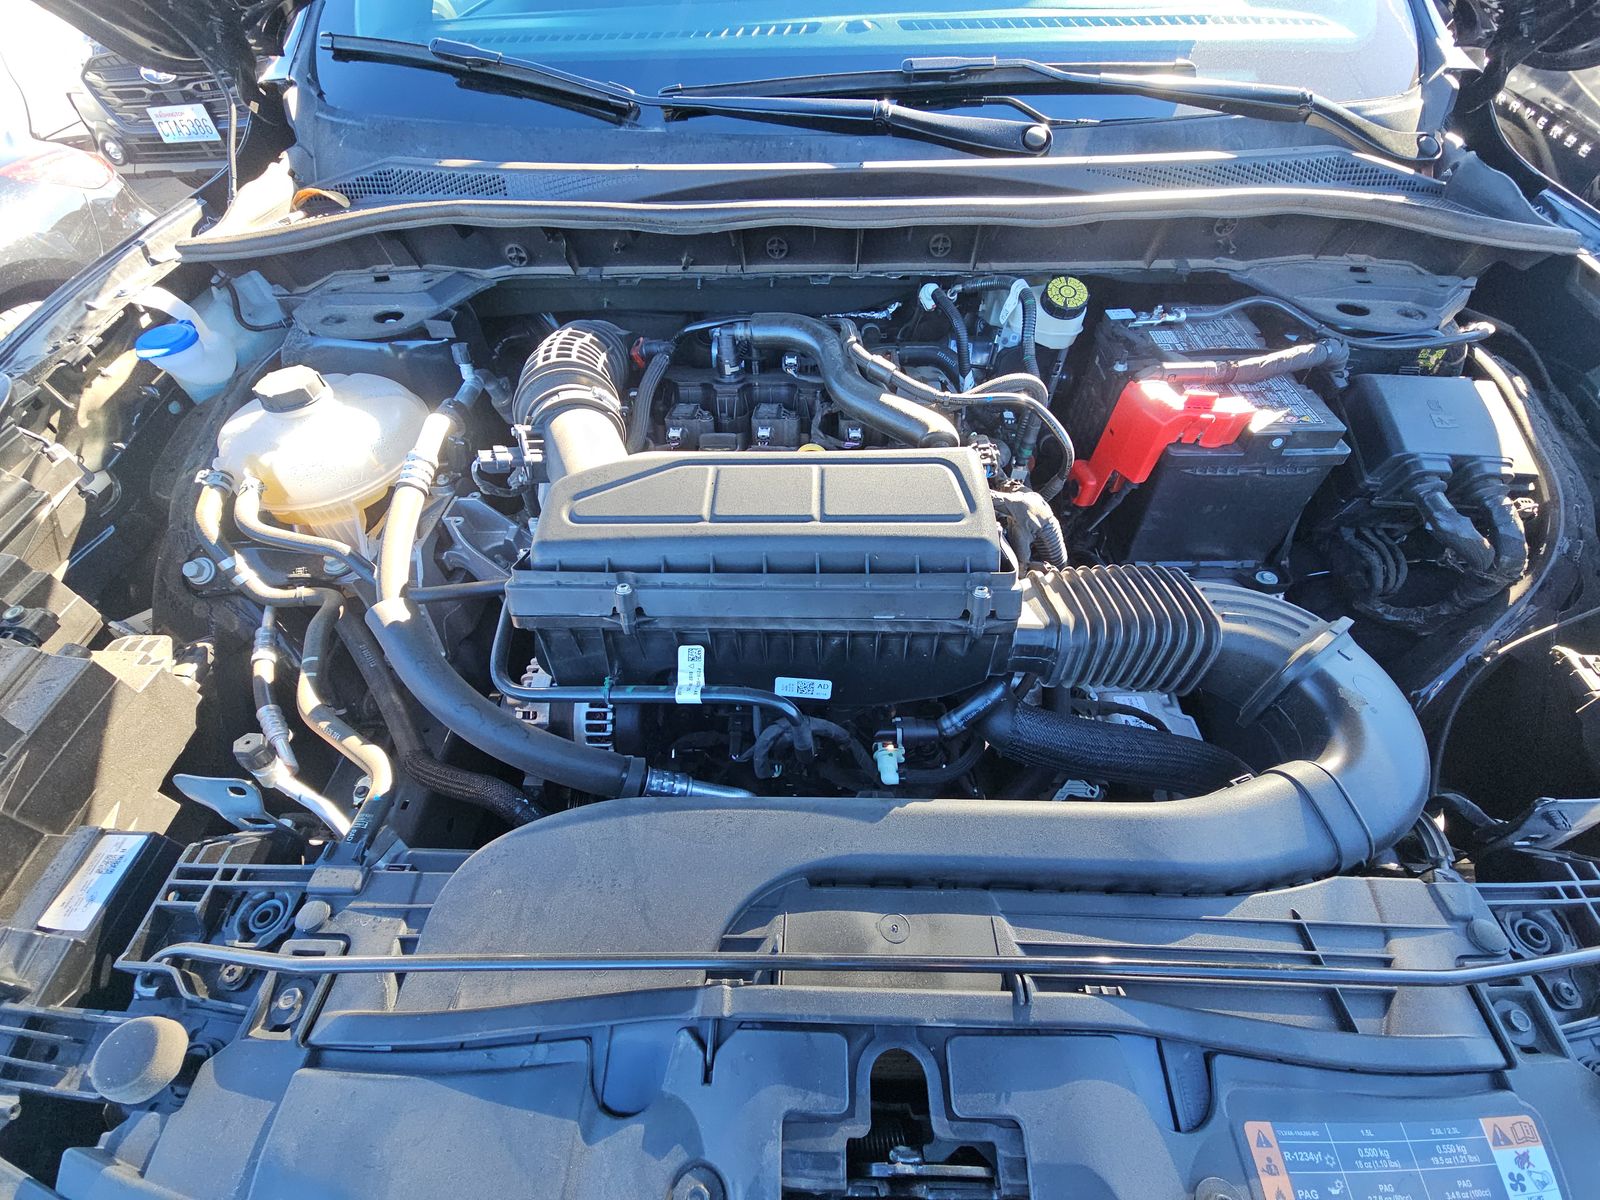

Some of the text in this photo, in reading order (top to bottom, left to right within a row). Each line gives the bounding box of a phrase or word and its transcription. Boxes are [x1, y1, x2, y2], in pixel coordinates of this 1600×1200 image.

[157, 118, 214, 138] CTA5386
[1495, 90, 1592, 158] RAVERSE
[1360, 1129, 1374, 1137] 1.5L
[1357, 1147, 1390, 1160] 0.500 kg
[1436, 1143, 1468, 1155] 0.550 kg
[1283, 1151, 1324, 1164] R-1234yf
[1378, 1183, 1395, 1192] PAG
[1457, 1180, 1473, 1188] PAG
[1298, 1189, 1319, 1199] PAG
